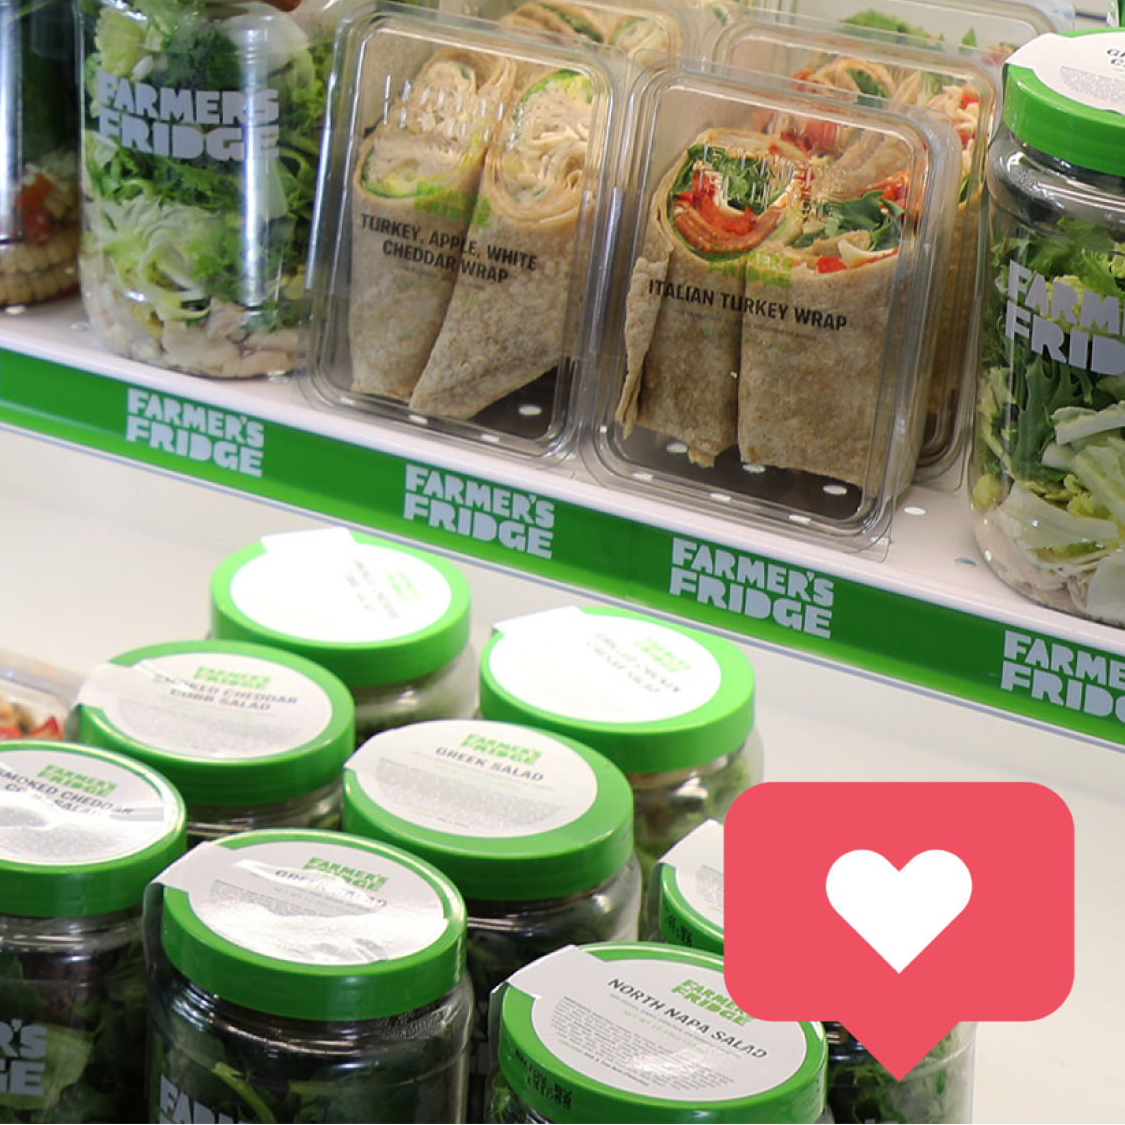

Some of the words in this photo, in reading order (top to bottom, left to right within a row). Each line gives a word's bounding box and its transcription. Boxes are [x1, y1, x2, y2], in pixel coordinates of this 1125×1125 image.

[99, 75, 280, 125] FARMER'S
[98, 114, 279, 162] FRIDGE
[360, 213, 424, 245] TURKEY,
[428, 231, 481, 259] APPLE,
[487, 243, 538, 271] WHITE
[382, 239, 457, 271] CHEDDAR
[460, 258, 509, 284] WRAP
[648, 278, 715, 307] ITALIAN
[720, 292, 789, 320] TURKEY
[793, 306, 848, 331] WRAP
[127, 387, 265, 449] FARMER'S
[125, 414, 264, 477] FRIDGE
[406, 463, 555, 529] FARMER'S
[403, 494, 553, 560] FRIDGE
[673, 537, 835, 606] FARMER'S
[669, 566, 832, 640] FRIDGE
[223, 686, 298, 705] CHEDDAR
[223, 695, 271, 711] SALAD
[435, 746, 488, 768] GREEK
[490, 761, 545, 782] SALAD
[60, 790, 135, 814] CHEDDAR
[607, 978, 667, 1011] NORTH
[663, 1007, 711, 1034] NAPA
[711, 1030, 768, 1058] SALAD
[671, 984, 751, 1027] FRIDGE
